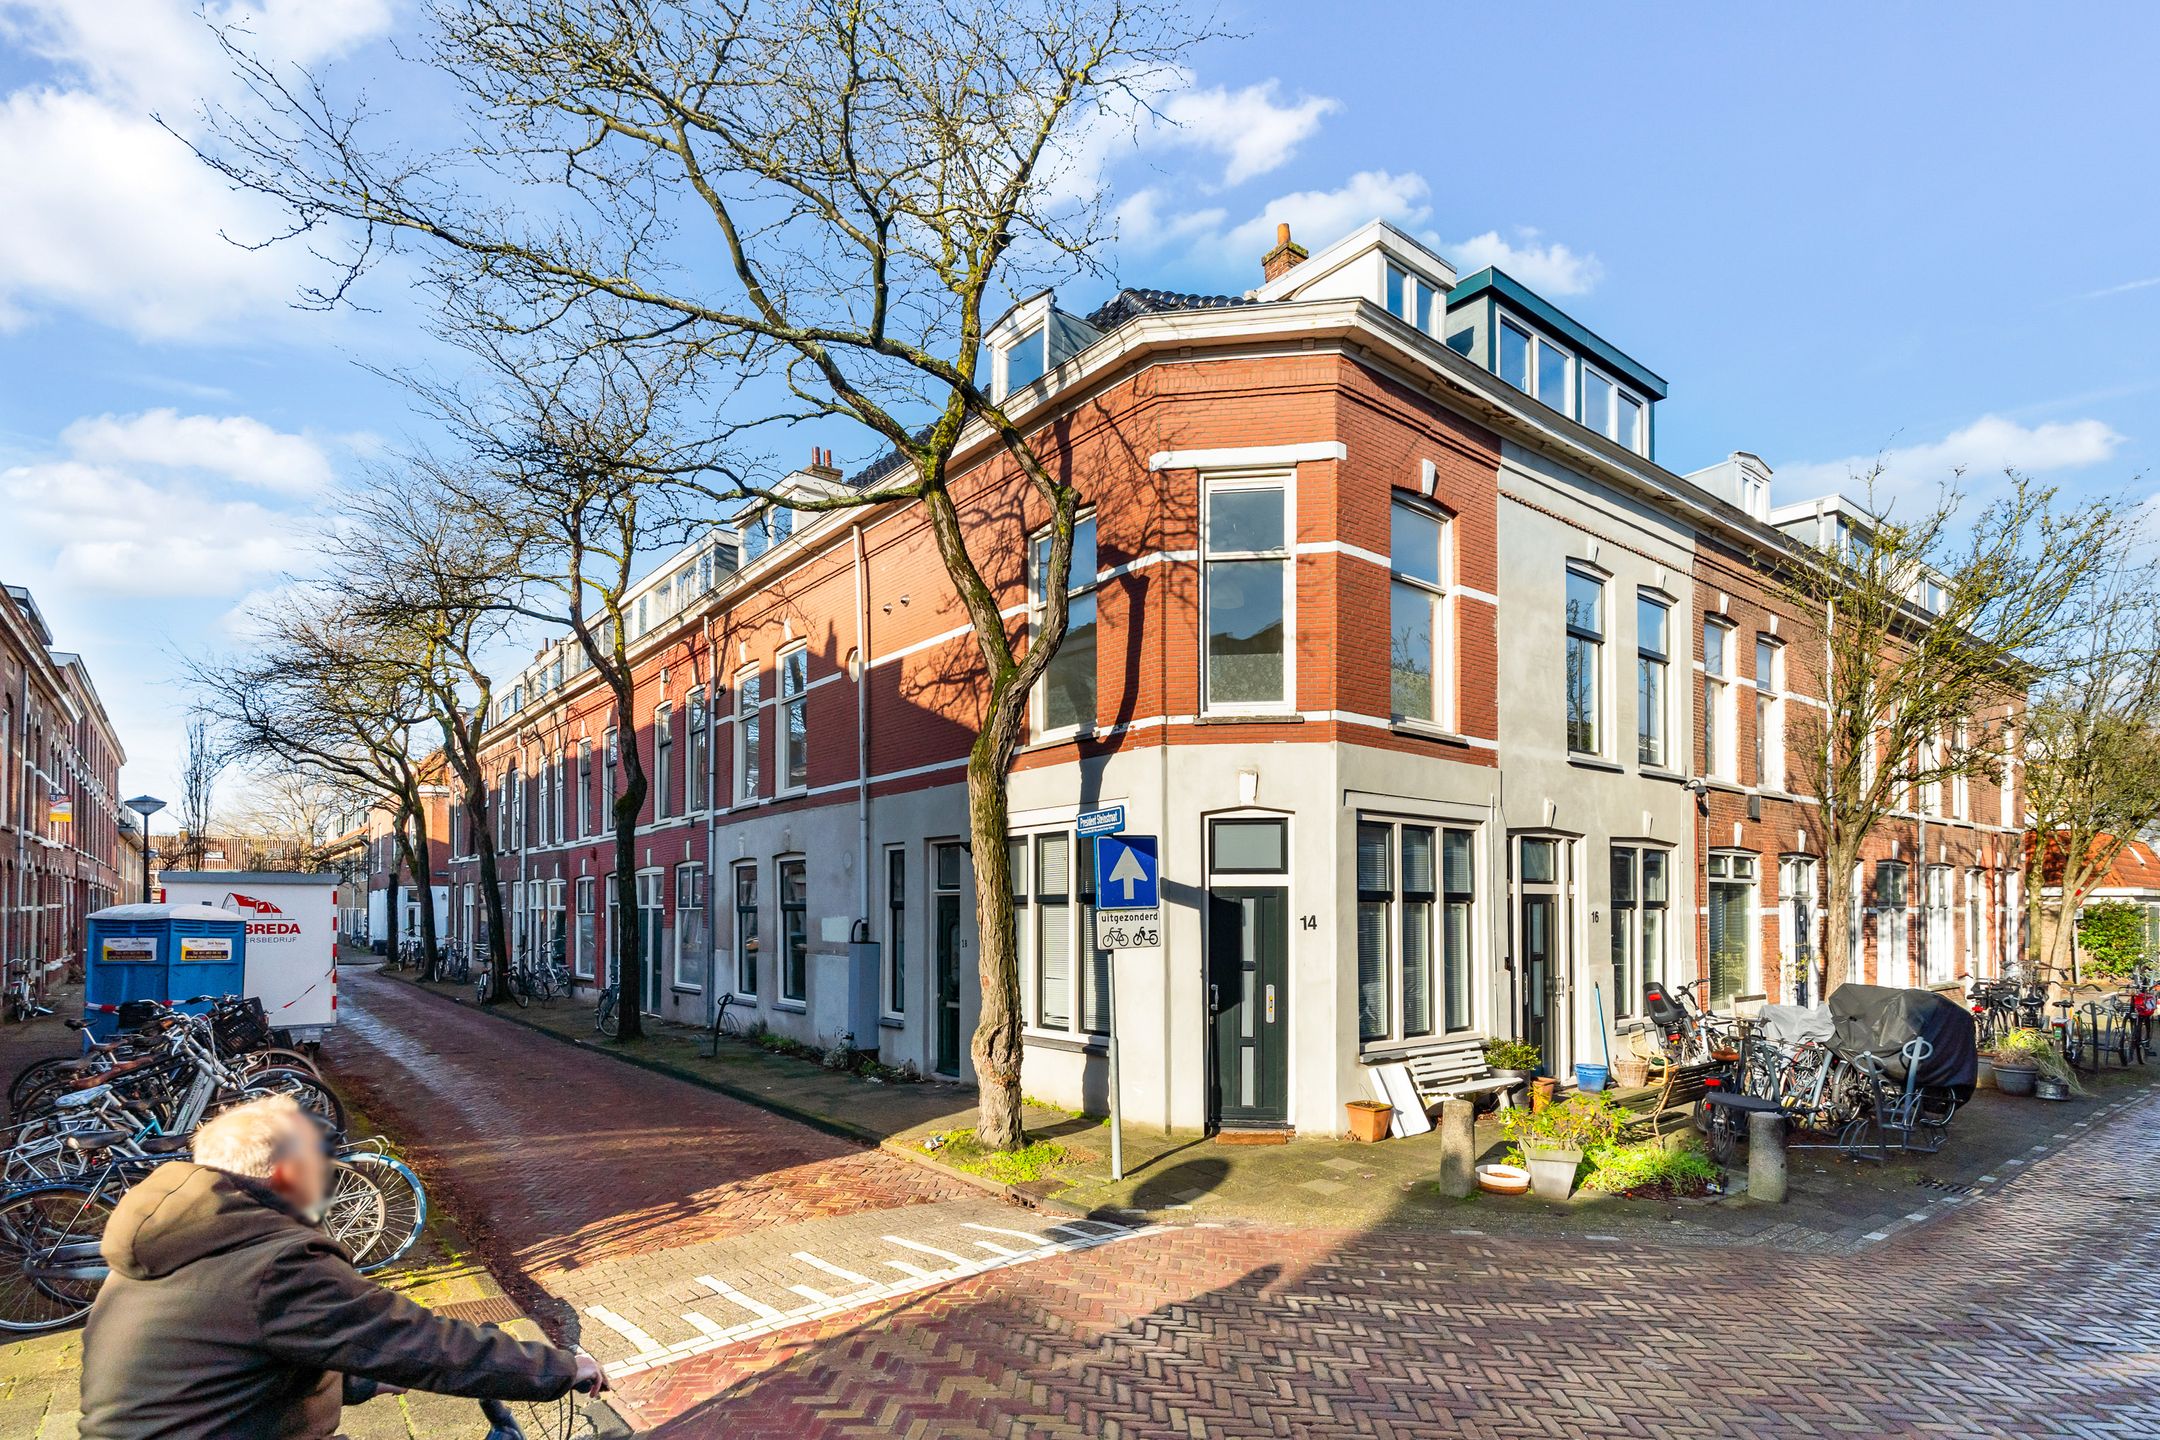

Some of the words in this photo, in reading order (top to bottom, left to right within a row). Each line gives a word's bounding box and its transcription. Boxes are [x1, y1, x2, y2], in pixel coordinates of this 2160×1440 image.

[1101, 912, 1158, 924] uitgezonderd
[1300, 915, 1317, 930] 14
[1591, 911, 1599, 923] 16
